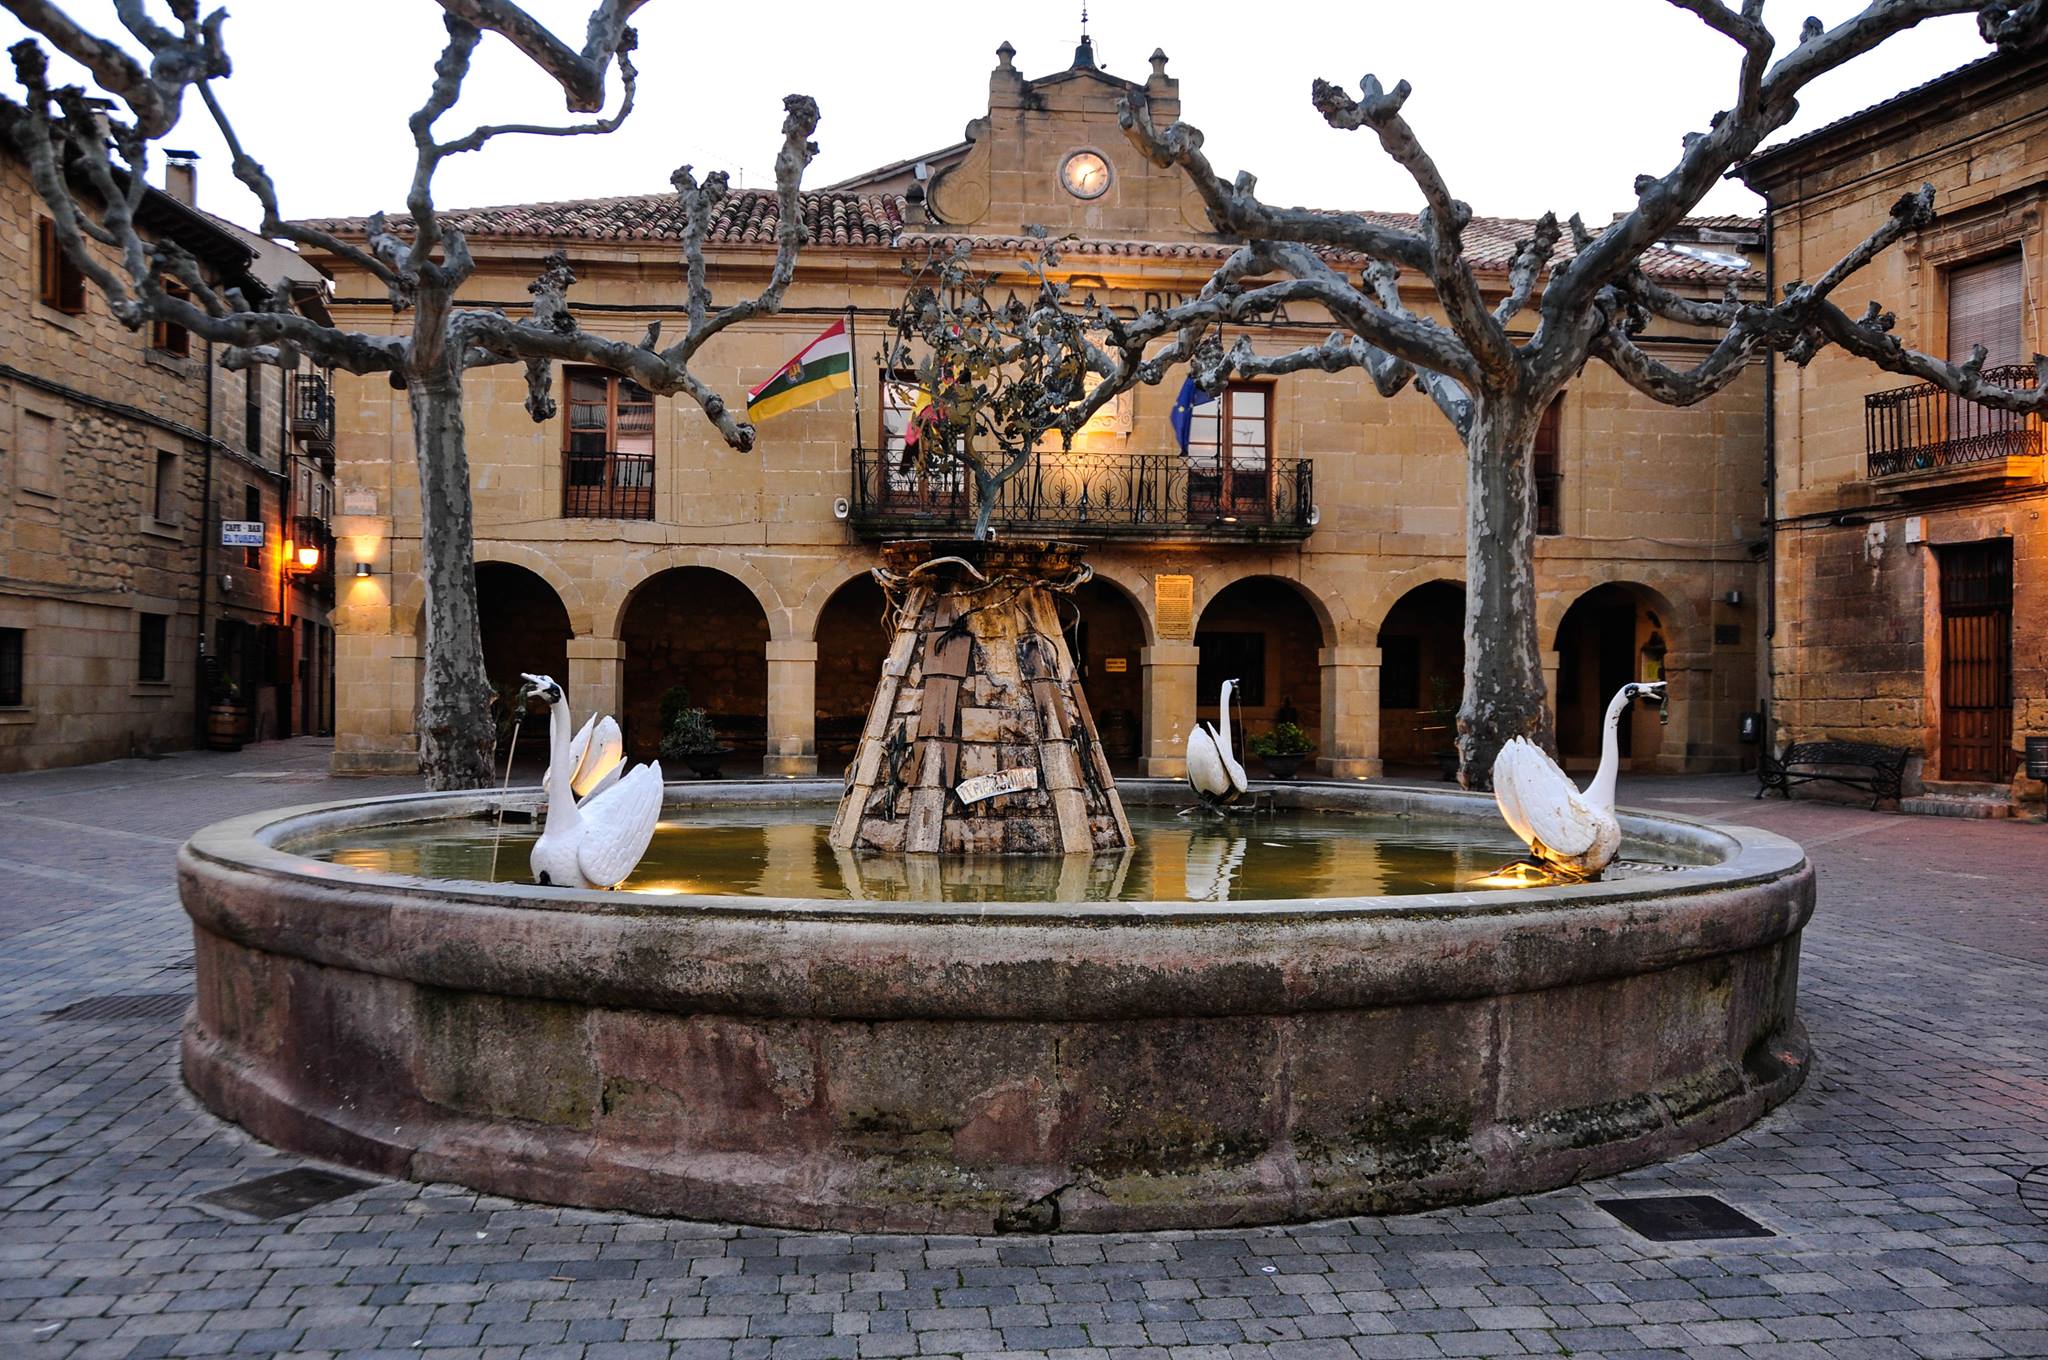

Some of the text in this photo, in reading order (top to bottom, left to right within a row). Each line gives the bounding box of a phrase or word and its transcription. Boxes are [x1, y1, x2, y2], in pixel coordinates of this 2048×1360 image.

[226, 524, 241, 532] CAFE
[248, 524, 261, 532] BAR
[224, 534, 233, 543] EL
